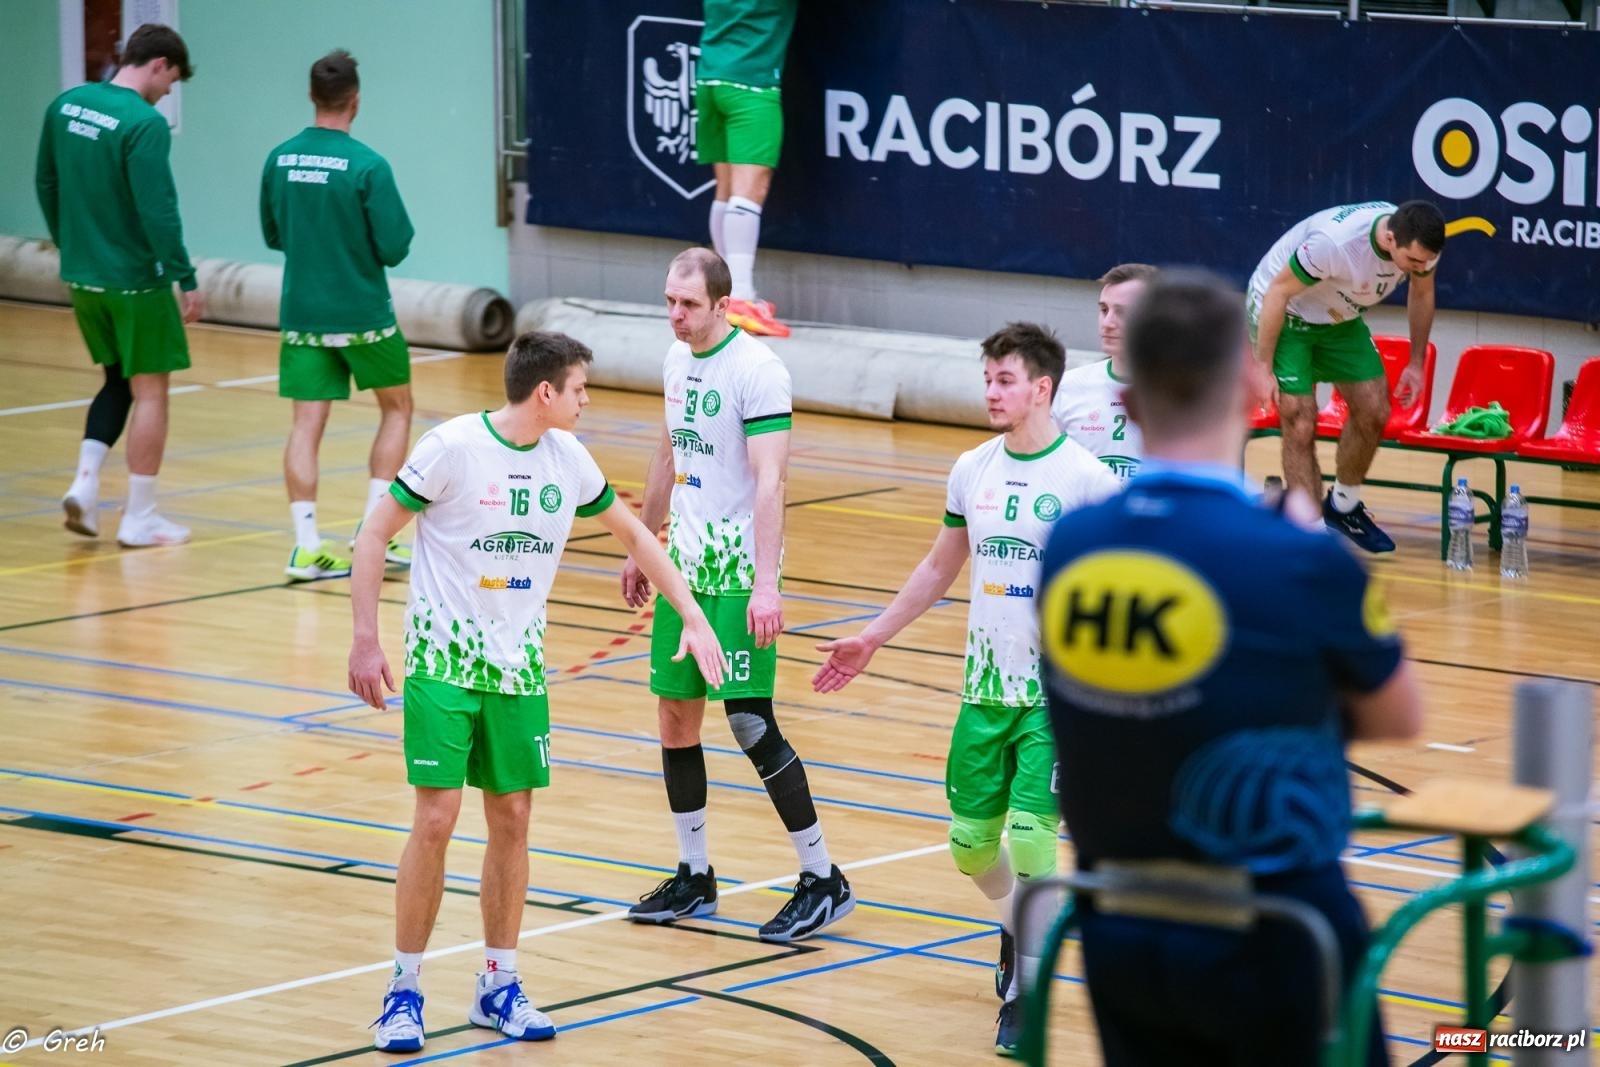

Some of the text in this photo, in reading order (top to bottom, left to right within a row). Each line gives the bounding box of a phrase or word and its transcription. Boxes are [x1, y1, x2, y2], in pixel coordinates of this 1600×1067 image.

[825, 82, 1221, 190] RACIBÓRZ
[1411, 97, 1600, 208] OSi
[686, 388, 699, 416] 13
[1112, 414, 1127, 441] 2
[509, 488, 530, 516] 16
[1005, 494, 1019, 521] 6
[469, 537, 554, 555] AGROTEAM
[1063, 587, 1184, 663] HK
[725, 650, 750, 682] 13
